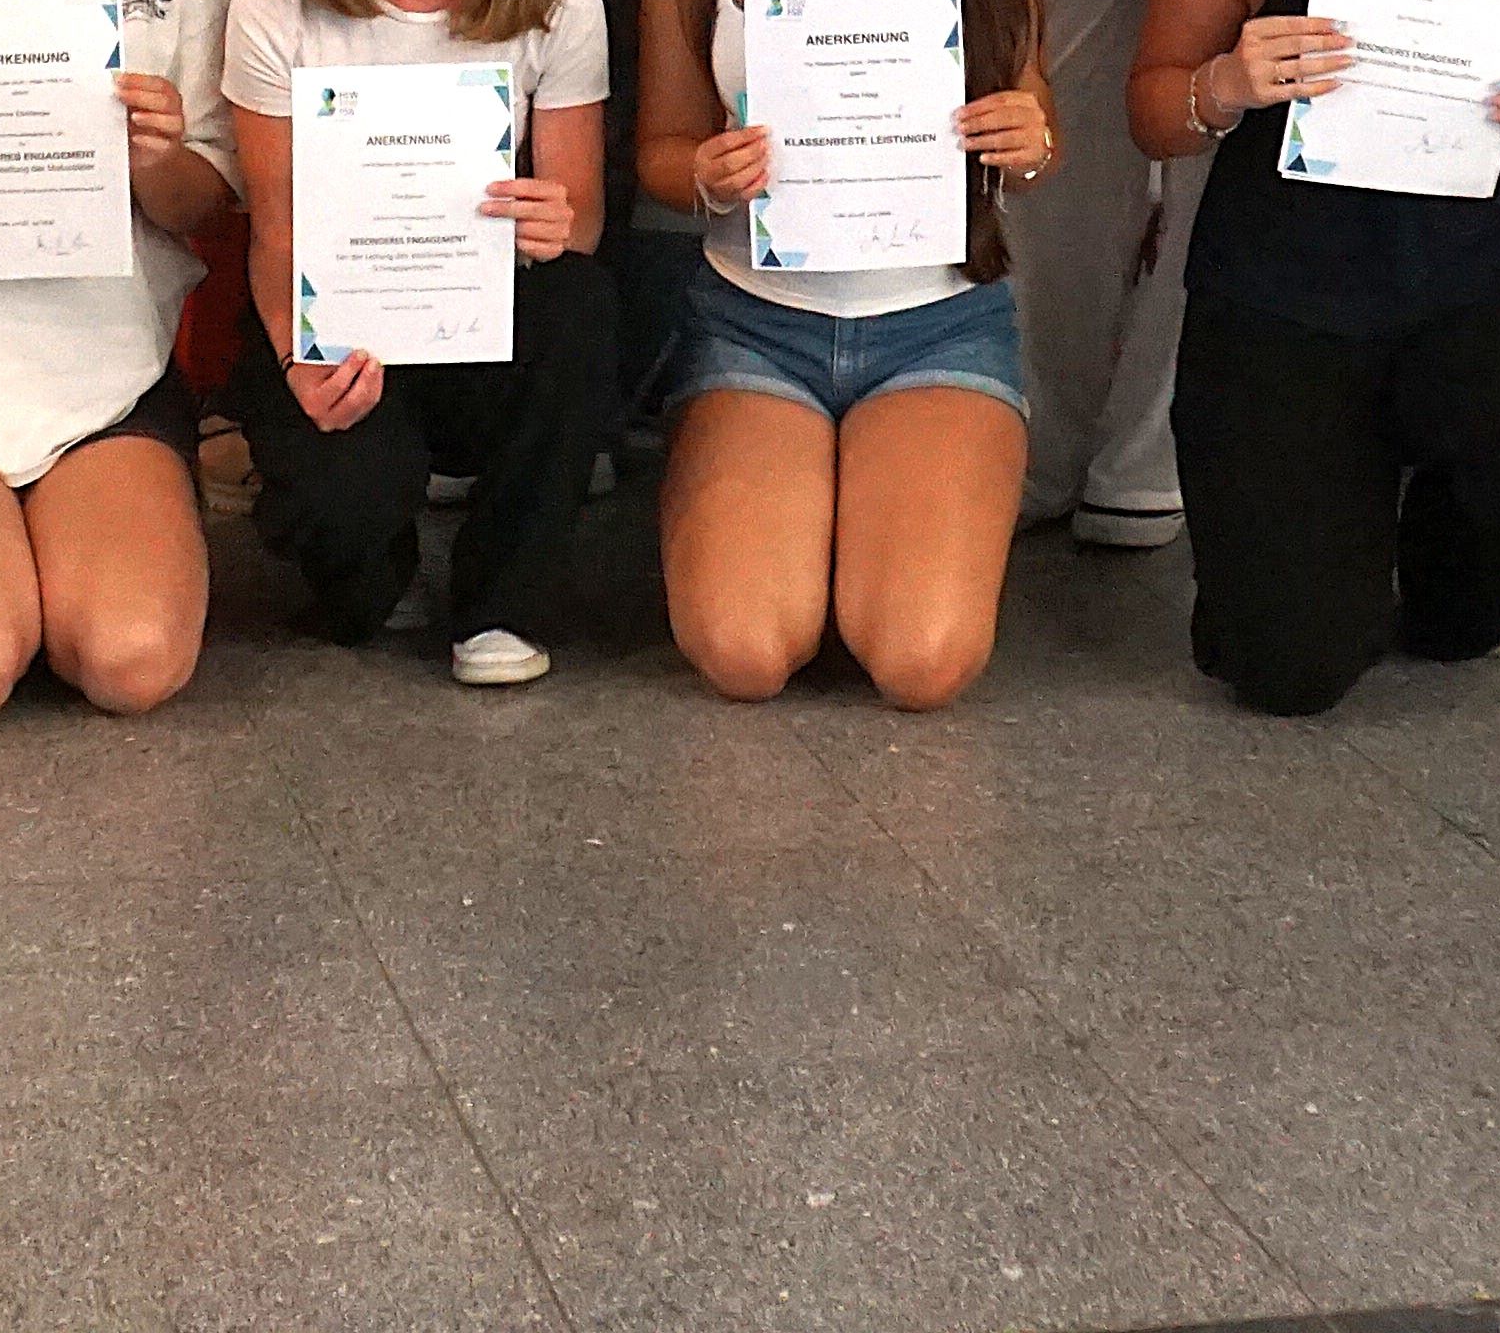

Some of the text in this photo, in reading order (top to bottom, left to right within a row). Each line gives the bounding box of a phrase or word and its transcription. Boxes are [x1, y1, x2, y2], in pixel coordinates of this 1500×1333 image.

[805, 31, 910, 47] ANERKENNUNG
[366, 134, 451, 147] ANERKENNUNG
[784, 133, 937, 148] KLASSENBESTE LEISTUNGEN
